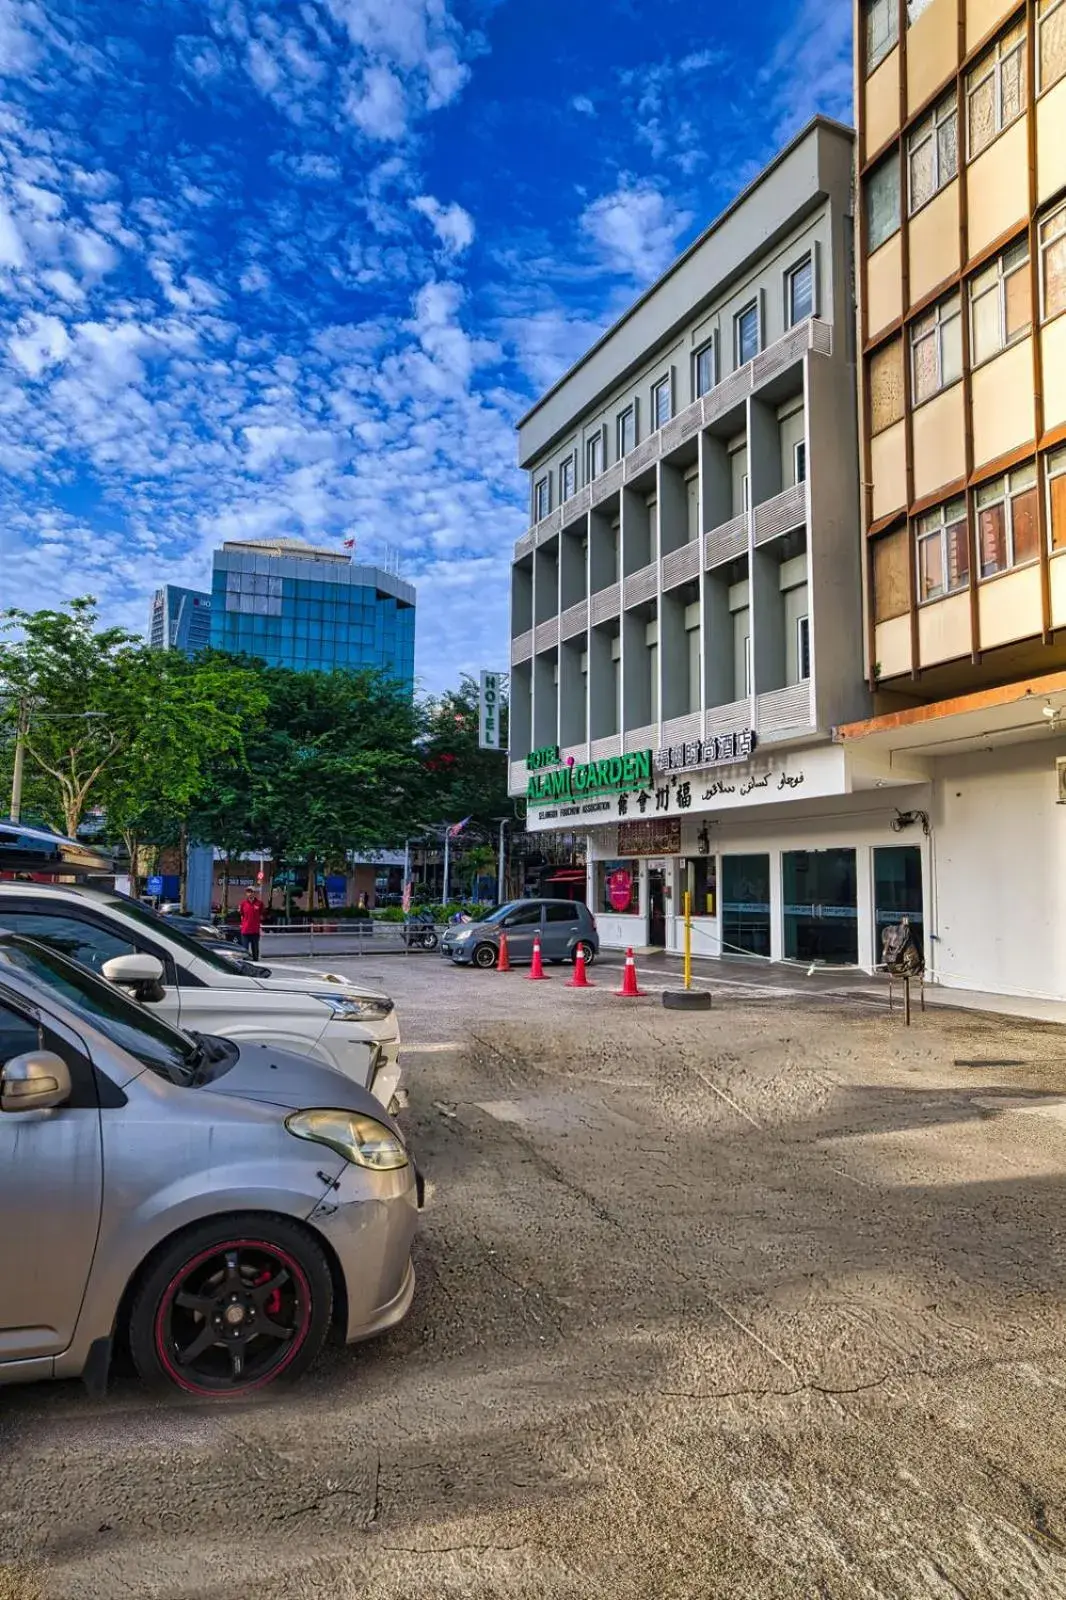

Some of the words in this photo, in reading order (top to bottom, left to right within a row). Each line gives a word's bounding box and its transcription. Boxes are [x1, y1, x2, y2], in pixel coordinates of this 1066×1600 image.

[485, 676, 496, 744] HOTEL
[526, 745, 560, 770] HOTEL
[526, 765, 573, 799] ALAMI
[574, 748, 653, 791] GARDEN
